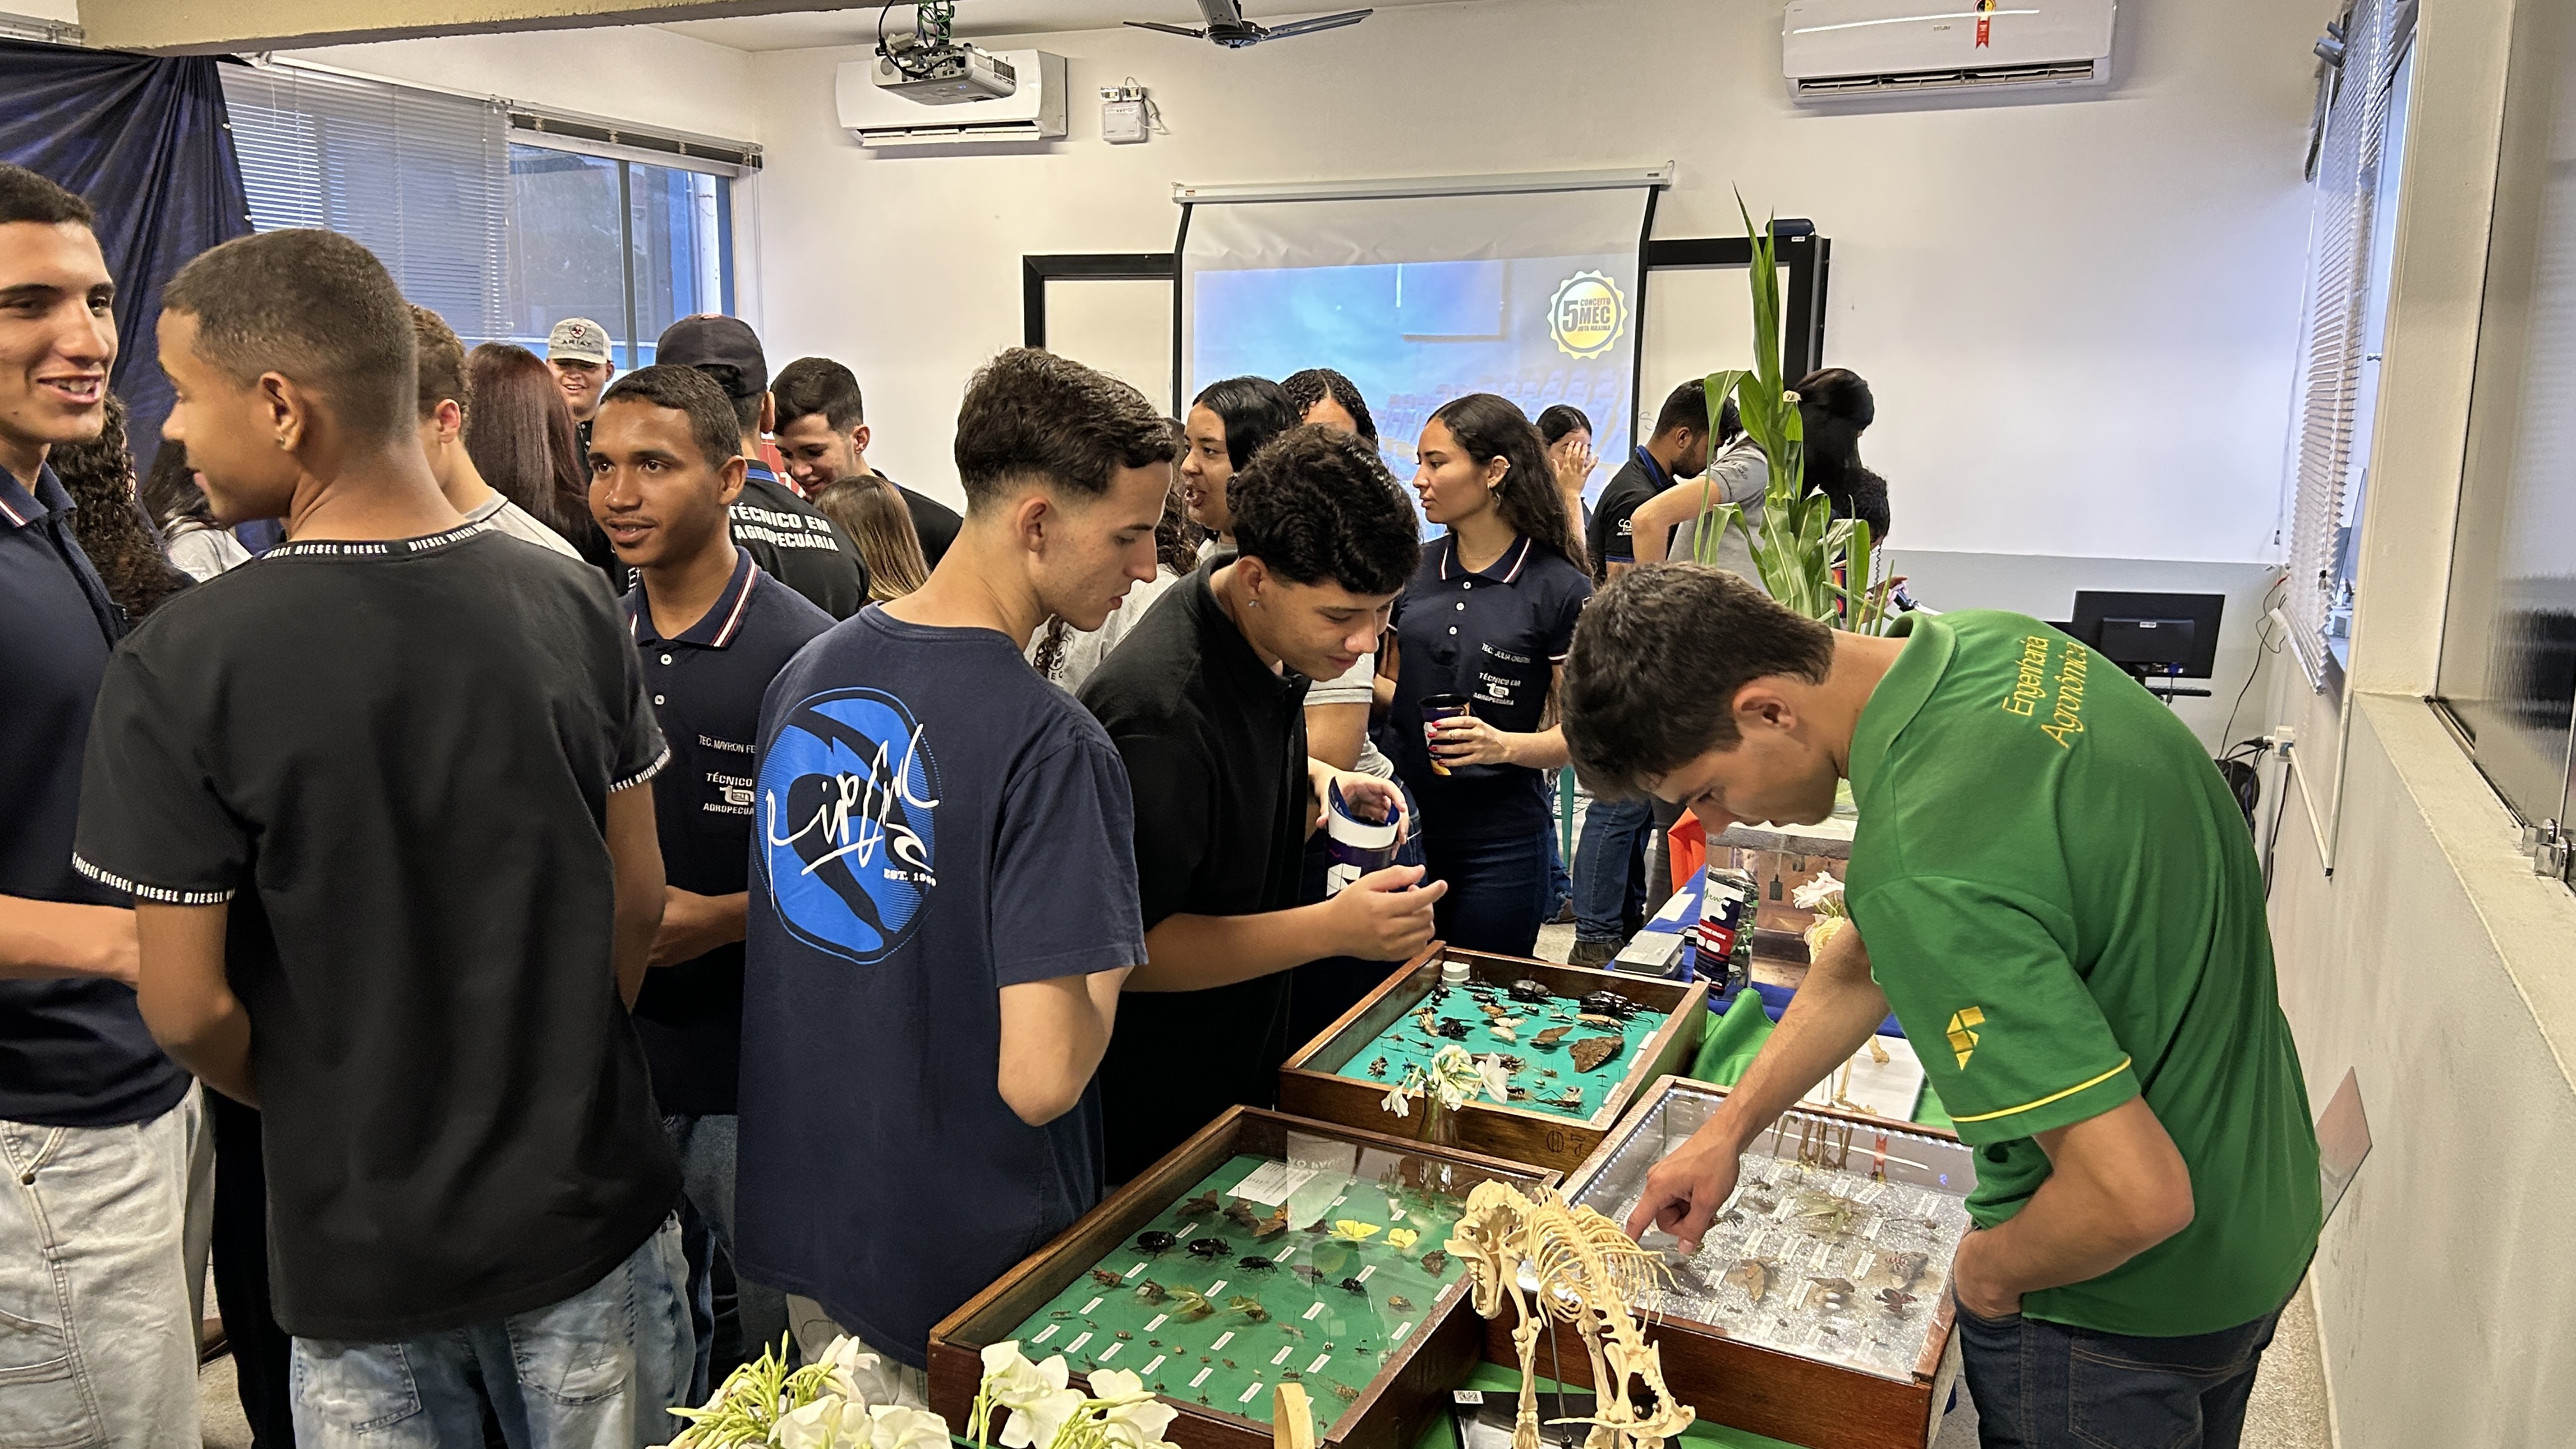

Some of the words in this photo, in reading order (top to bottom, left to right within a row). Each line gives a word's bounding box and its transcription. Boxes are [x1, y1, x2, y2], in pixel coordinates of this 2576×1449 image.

[1580, 297, 1611, 307] CONCEITO
[1562, 300, 1579, 332] 5
[1579, 305, 1611, 325] MEC
[729, 502, 802, 529] TÉCNICO
[804, 515, 832, 533] EM
[295, 544, 338, 555] DIESEL
[344, 544, 388, 555] DIESEL
[408, 536, 448, 551] DIESEL
[734, 525, 840, 551] AGROPECUÁRIA
[2002, 636, 2049, 716] Engenharia
[2041, 641, 2087, 749] Agronômica
[714, 739, 744, 753] MAYRON
[610, 777, 634, 793] ESEL
[706, 772, 753, 787] TÉCNICO
[100, 871, 132, 892] DIESEL
[136, 884, 179, 902] DIESEL
[184, 891, 224, 903] DIESEL
